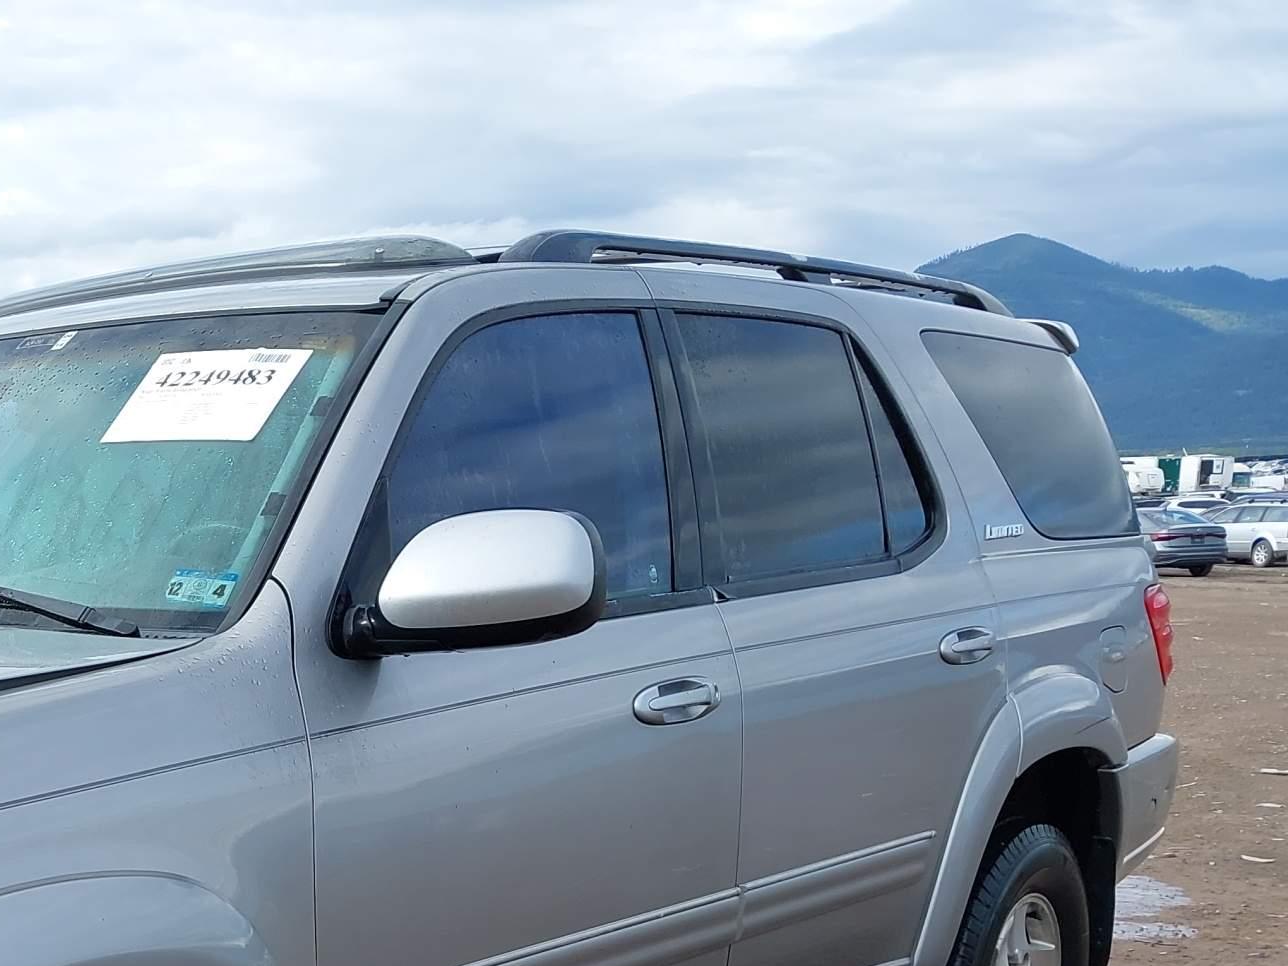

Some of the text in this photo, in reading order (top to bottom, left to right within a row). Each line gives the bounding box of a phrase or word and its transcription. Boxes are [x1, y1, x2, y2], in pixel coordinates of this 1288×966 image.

[155, 368, 276, 387] 42249483
[168, 581, 183, 596] 12
[213, 584, 227, 598] 4
